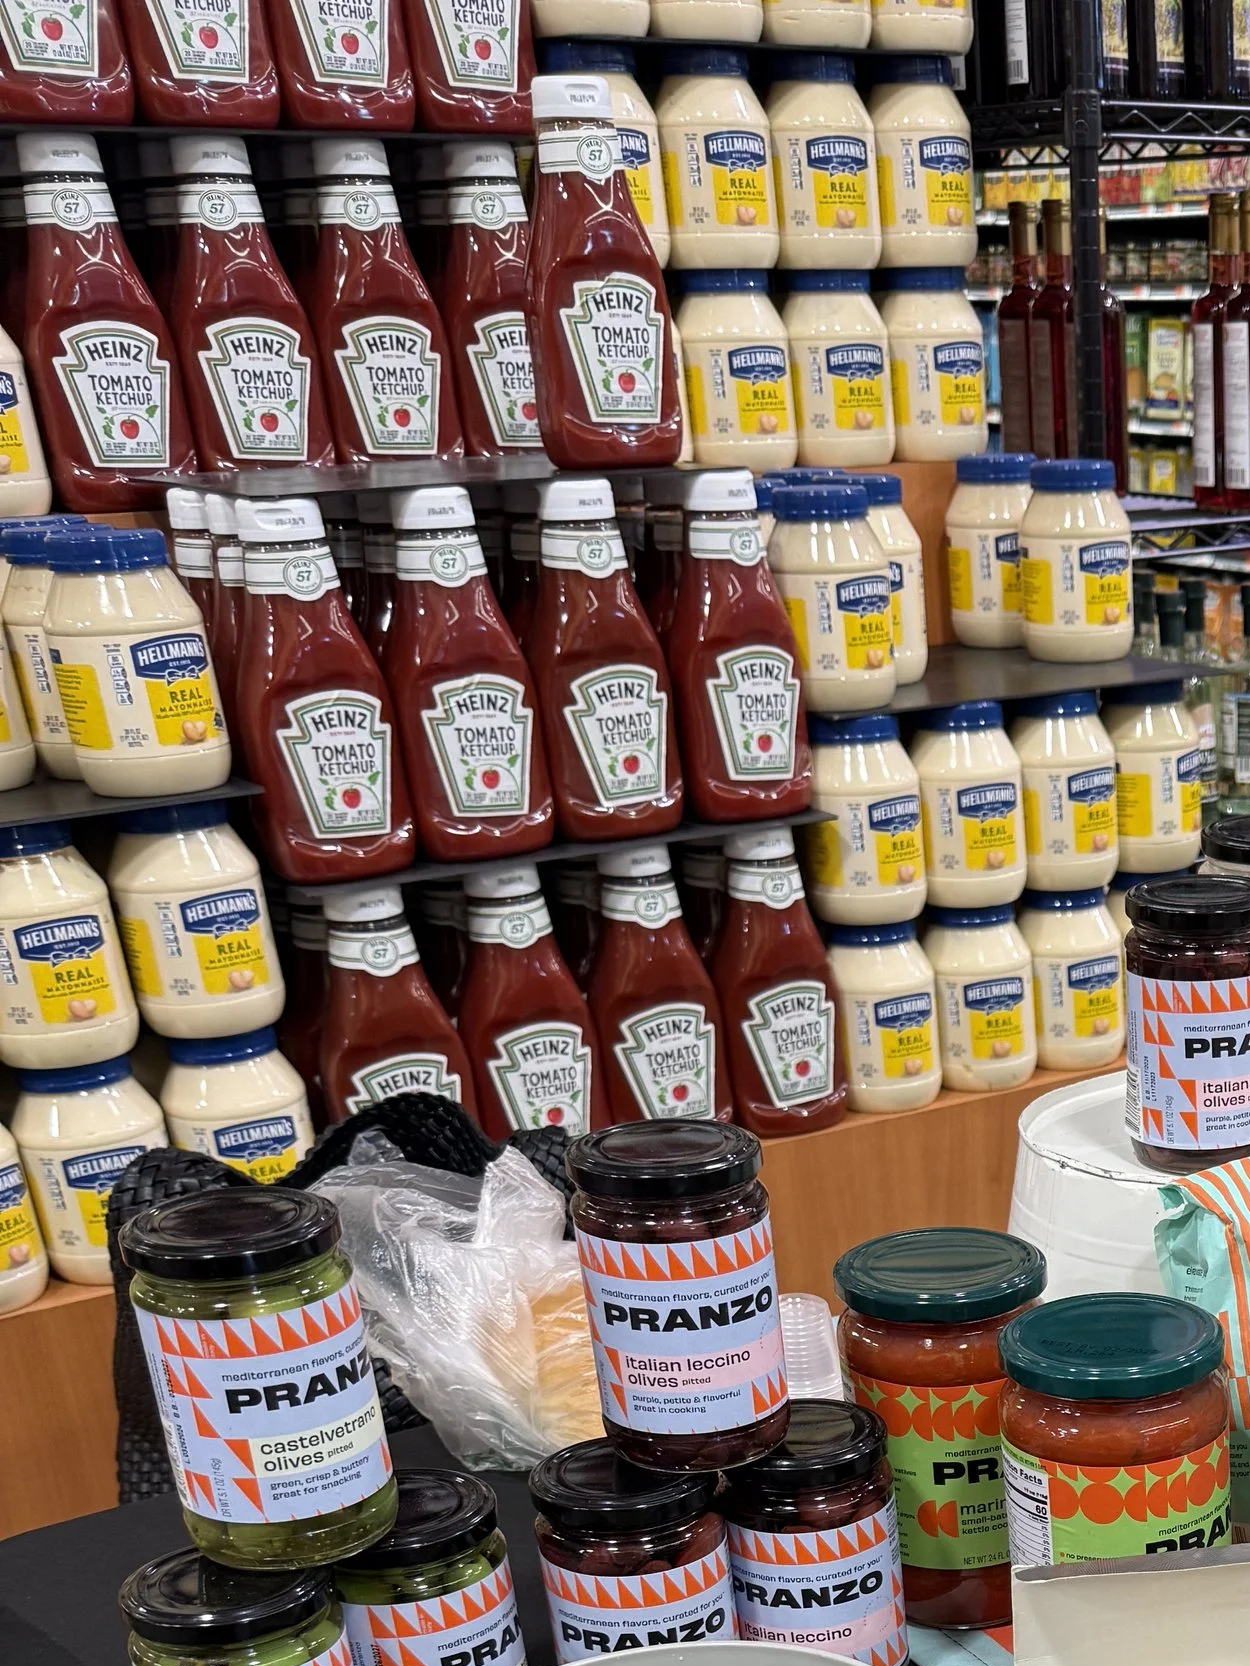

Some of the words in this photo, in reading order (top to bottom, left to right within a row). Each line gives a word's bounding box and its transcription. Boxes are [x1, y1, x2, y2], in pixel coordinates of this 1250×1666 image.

[588, 145, 603, 162] 57
[709, 136, 764, 155] HELLMANN'S
[811, 141, 865, 158] HELLMANN'S
[729, 179, 757, 190] REAL
[830, 182, 858, 193] REAL
[63, 201, 80, 214] 57
[593, 291, 644, 316] HEINZ
[592, 325, 650, 344] TOMATO
[85, 339, 144, 363] HEINZ
[230, 336, 286, 358] HEINZ
[597, 343, 650, 359] KETCHUP
[88, 375, 152, 391] TOMATO
[231, 369, 293, 386] TOMATO
[96, 392, 152, 405] KETCHUP
[238, 386, 293, 400] KETCHUP
[137, 638, 205, 666] HELLMANN'S
[169, 687, 203, 703] REAL
[456, 694, 509, 715] HEINZ
[455, 727, 516, 743] TOMATO
[460, 743, 515, 757] KETCHUP
[185, 895, 256, 923] HELLMANN'S
[21, 919, 99, 949] HELLMANN'S
[216, 939, 251, 954] REAL
[55, 967, 94, 983] REAL
[520, 1039, 570, 1061] HEINZ
[520, 1067, 577, 1087] TOMATO
[1203, 1075, 1249, 1093] italian
[527, 1082, 576, 1099] KETCHUP
[1204, 1094, 1246, 1107] olives
[601, 1288, 670, 1302] mediterranean
[673, 1292, 712, 1302] flavors,
[714, 1281, 749, 1297] curated
[750, 1277, 760, 1287] for
[604, 1285, 772, 1332] PRANZO
[222, 1363, 309, 1383] mediterranean
[311, 1350, 345, 1367] flavors,
[626, 1356, 681, 1371] italian
[687, 1350, 750, 1369] leccino
[628, 1373, 678, 1388] olives
[682, 1376, 711, 1386] pitted
[633, 1395, 662, 1404] purple,
[703, 1390, 740, 1402] flavorful
[634, 1405, 655, 1413] great
[260, 1405, 376, 1455] castelvetrano
[264, 1451, 324, 1472] olives
[328, 1442, 354, 1458] pitted
[270, 1476, 303, 1491] green,
[306, 1470, 331, 1486] crisp
[332, 1468, 340, 1477] &
[341, 1455, 370, 1475] buttery
[1020, 1469, 1042, 1485] Facts
[272, 1487, 302, 1501] great
[304, 1482, 319, 1494] for
[321, 1470, 361, 1492] snacking
[1036, 1505, 1047, 1515] 60
[732, 1570, 883, 1609] PRANZO
[561, 1607, 726, 1653] PRANZO
[744, 1622, 786, 1643] italian
[791, 1626, 852, 1644] leccino
